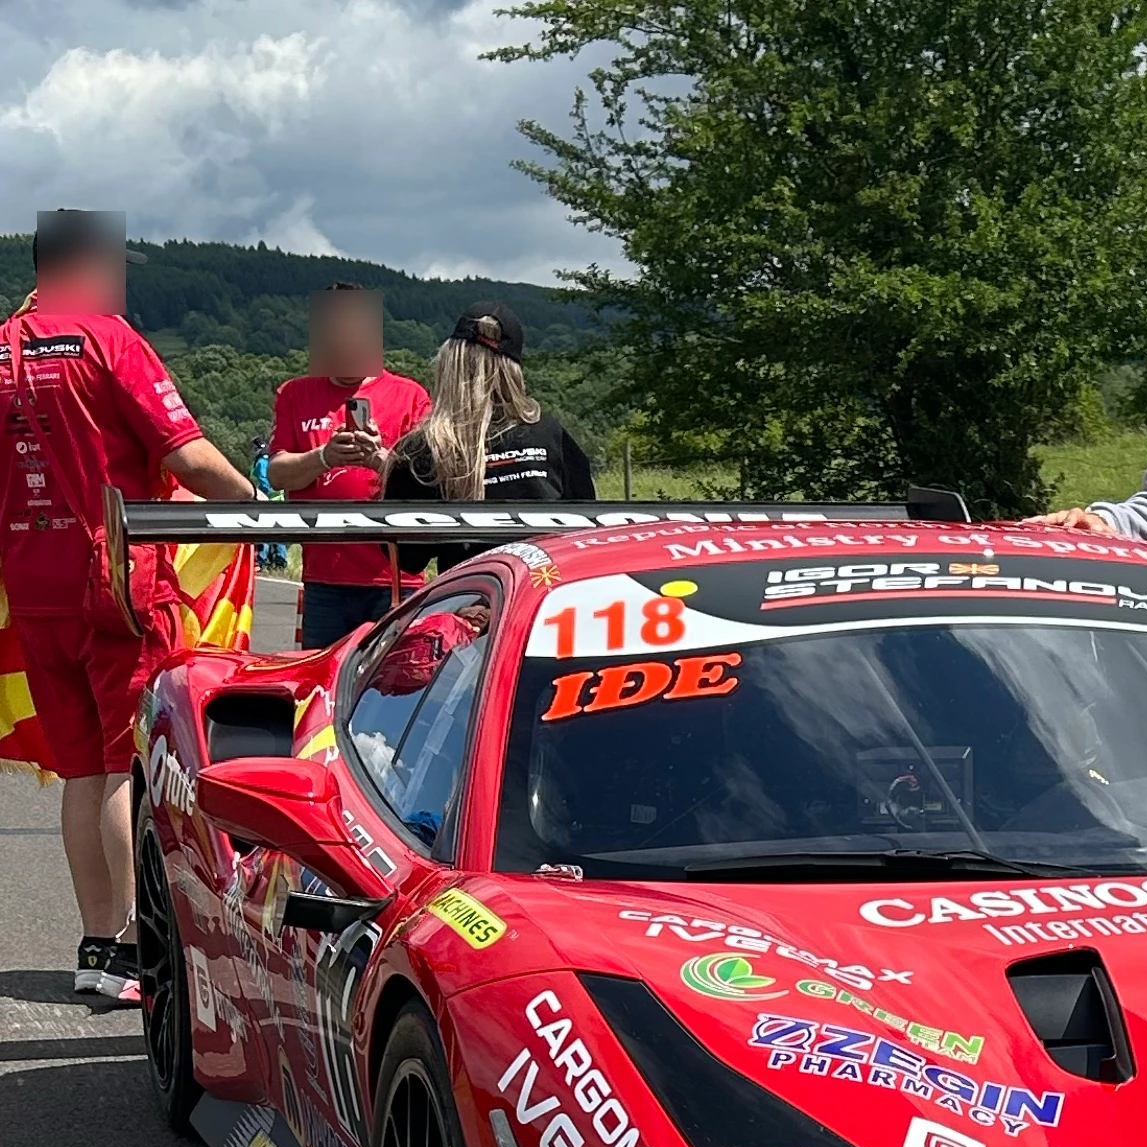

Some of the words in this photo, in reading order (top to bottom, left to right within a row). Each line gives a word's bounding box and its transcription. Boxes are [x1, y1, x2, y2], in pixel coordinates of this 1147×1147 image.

[302, 417, 332, 432] VLT
[663, 532, 920, 560] Ministry
[939, 532, 993, 547] of
[767, 562, 940, 583] IGOR
[543, 596, 686, 659] 118
[795, 979, 985, 1058] GREEN
[767, 1051, 1030, 1137] PHARMACY
